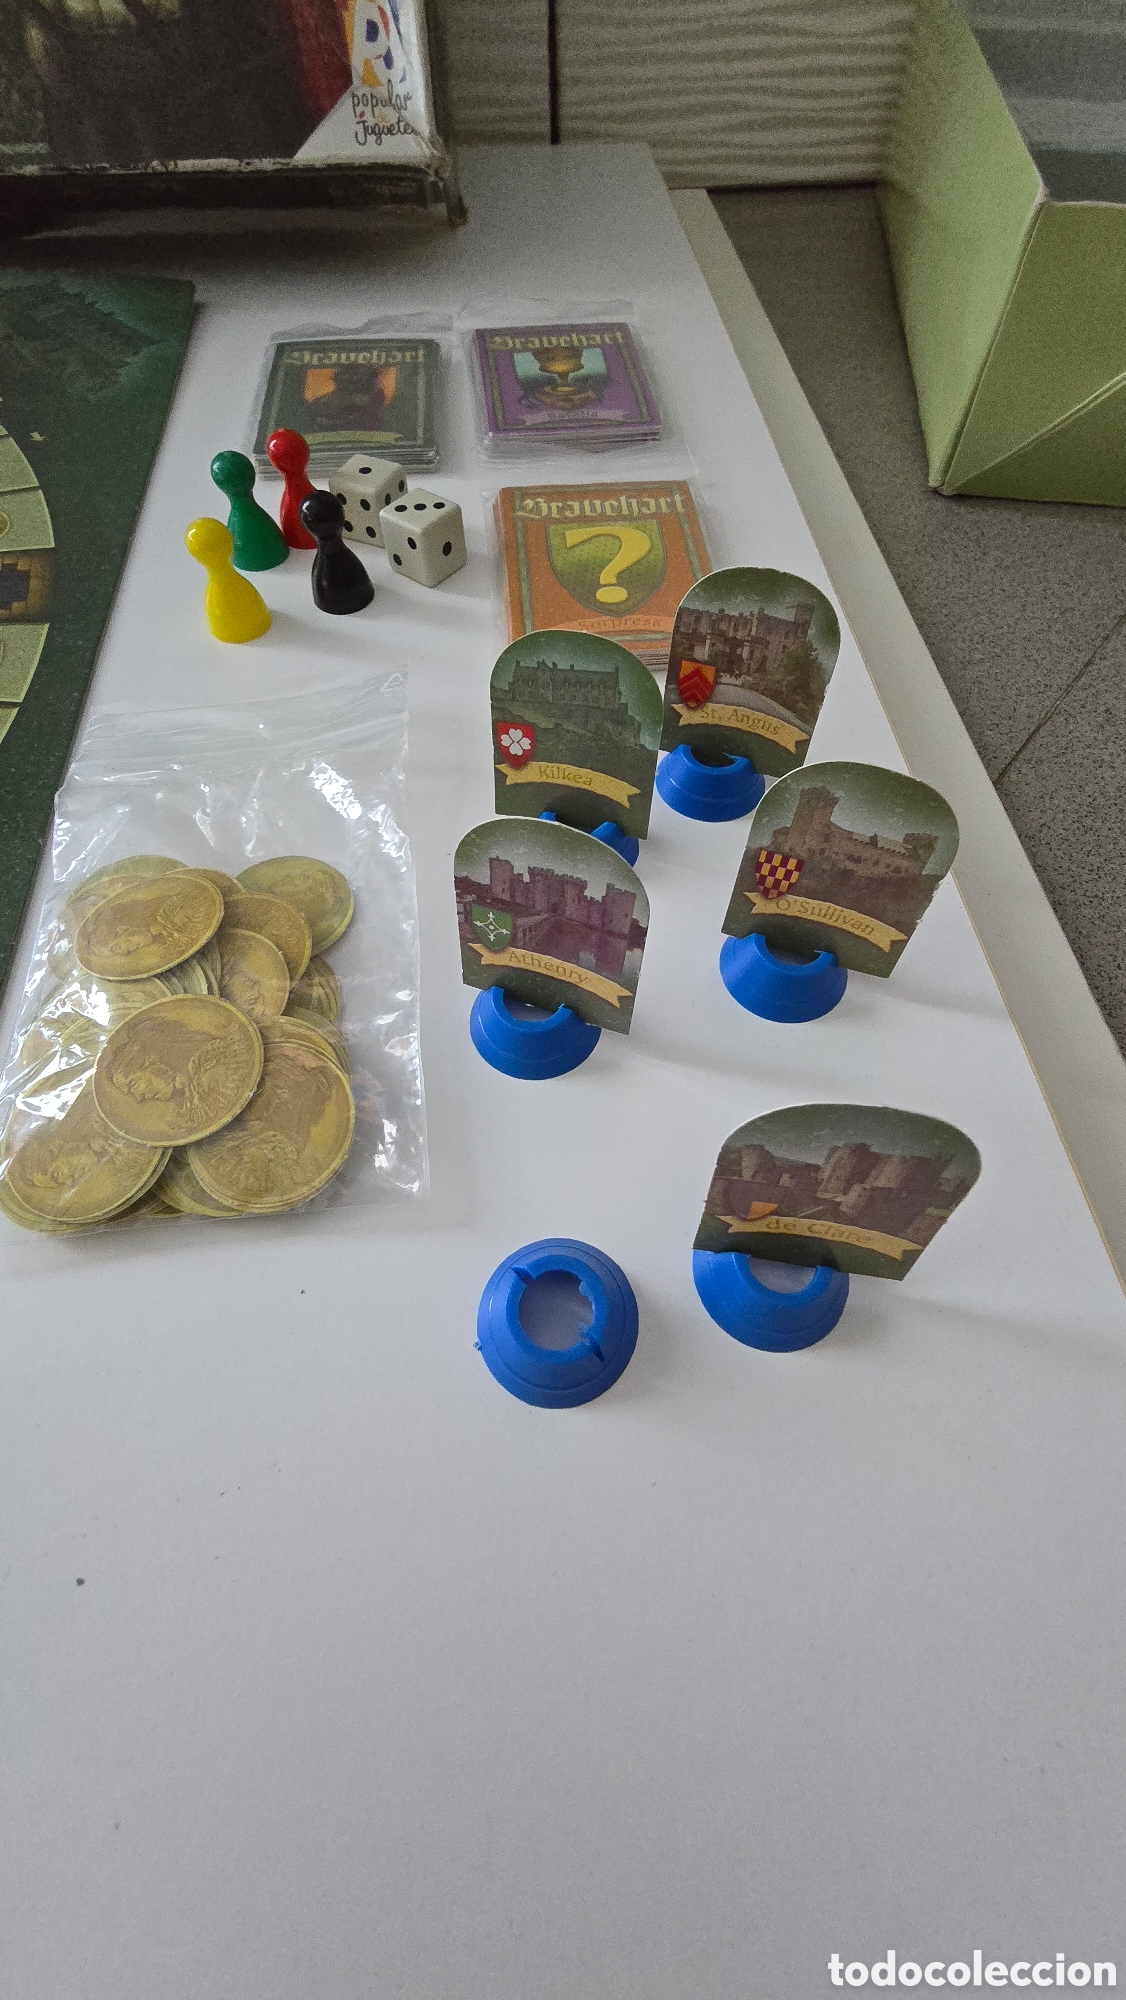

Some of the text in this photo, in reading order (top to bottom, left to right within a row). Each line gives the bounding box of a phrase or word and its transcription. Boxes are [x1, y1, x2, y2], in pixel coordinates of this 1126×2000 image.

[351, 79, 412, 118] popular
[355, 117, 421, 146] Juguete
[515, 494, 684, 519] Bravehart
[700, 704, 781, 736] St. Angus
[538, 765, 593, 787] Kilkea
[775, 899, 875, 936] O'Sullivan
[508, 950, 589, 984] Athenry
[765, 1218, 873, 1245] de Clare
